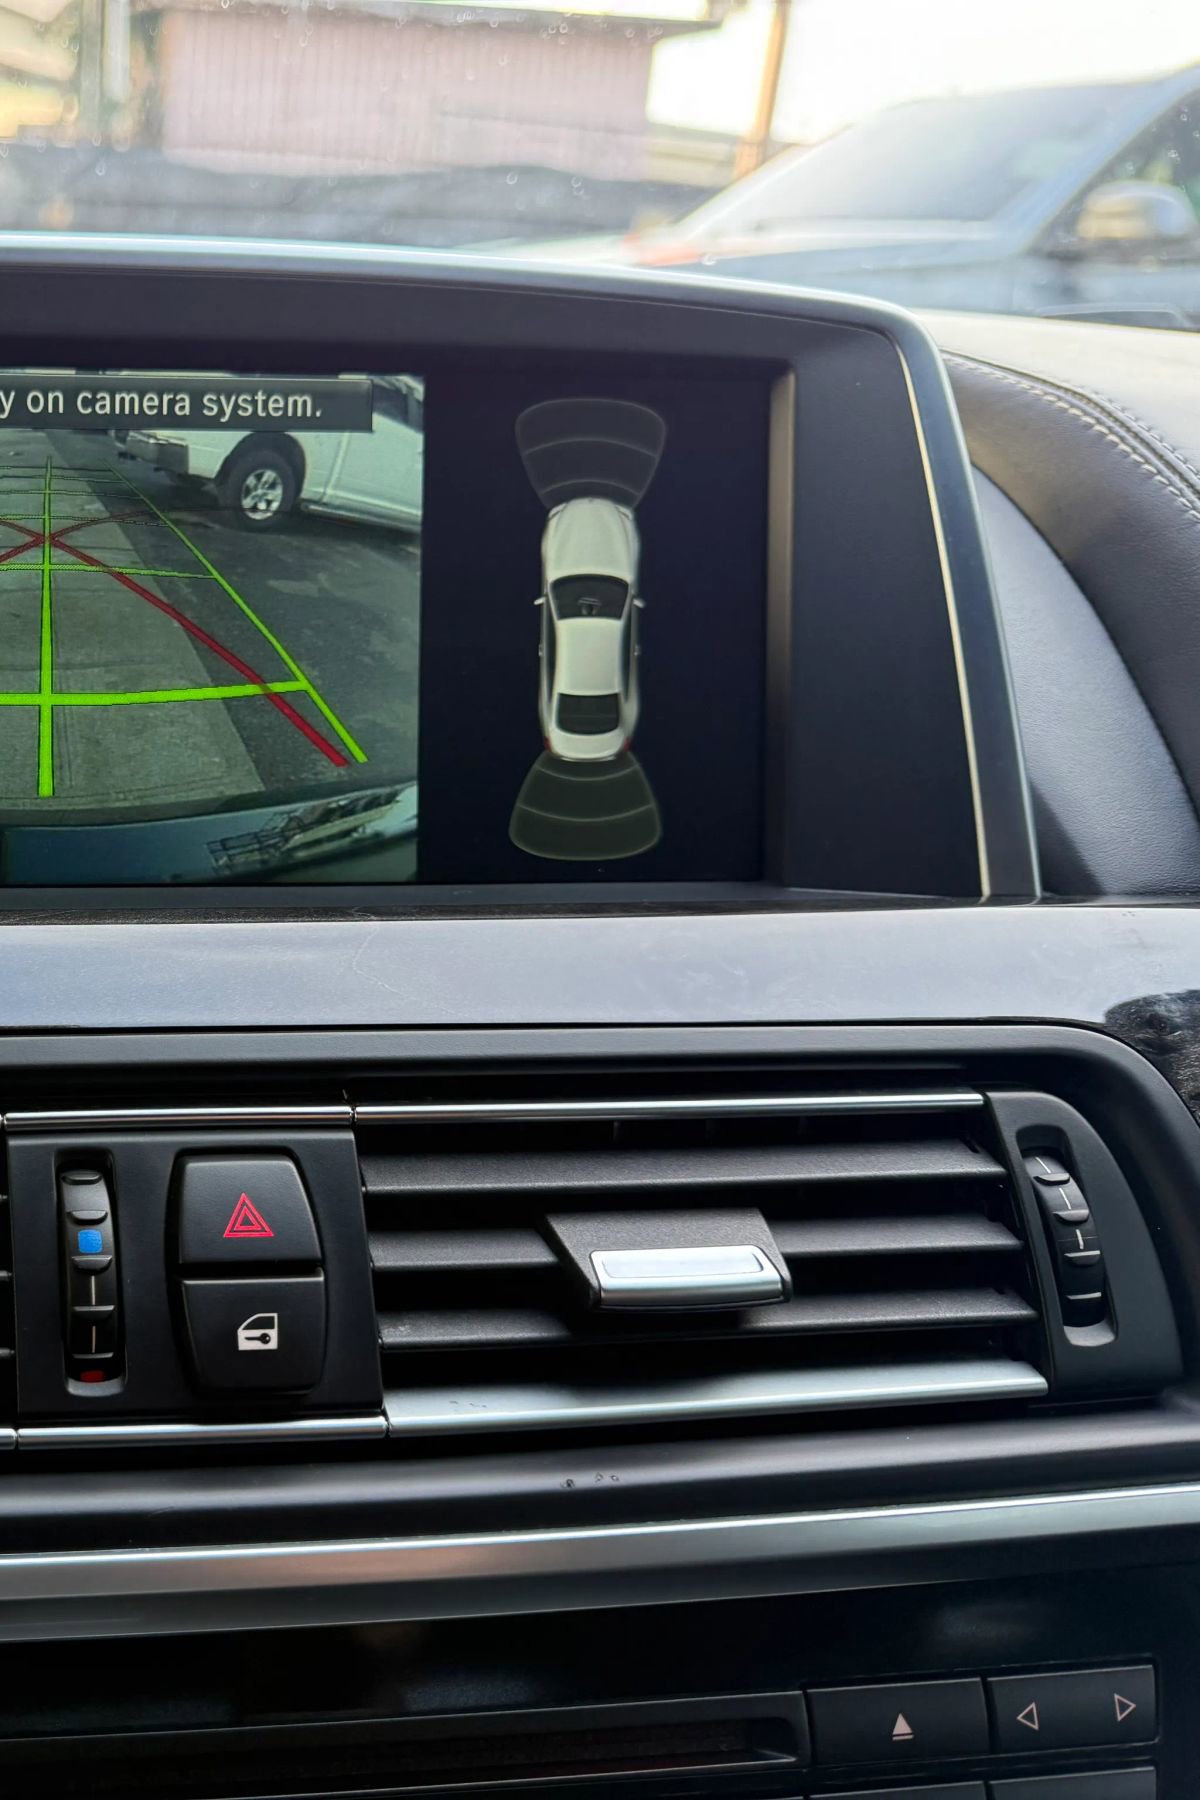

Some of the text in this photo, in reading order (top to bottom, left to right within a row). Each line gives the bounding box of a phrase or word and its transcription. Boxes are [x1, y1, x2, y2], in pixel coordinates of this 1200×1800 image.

[26, 389, 64, 414] on
[75, 391, 191, 416] camera
[201, 388, 322, 421] system.
